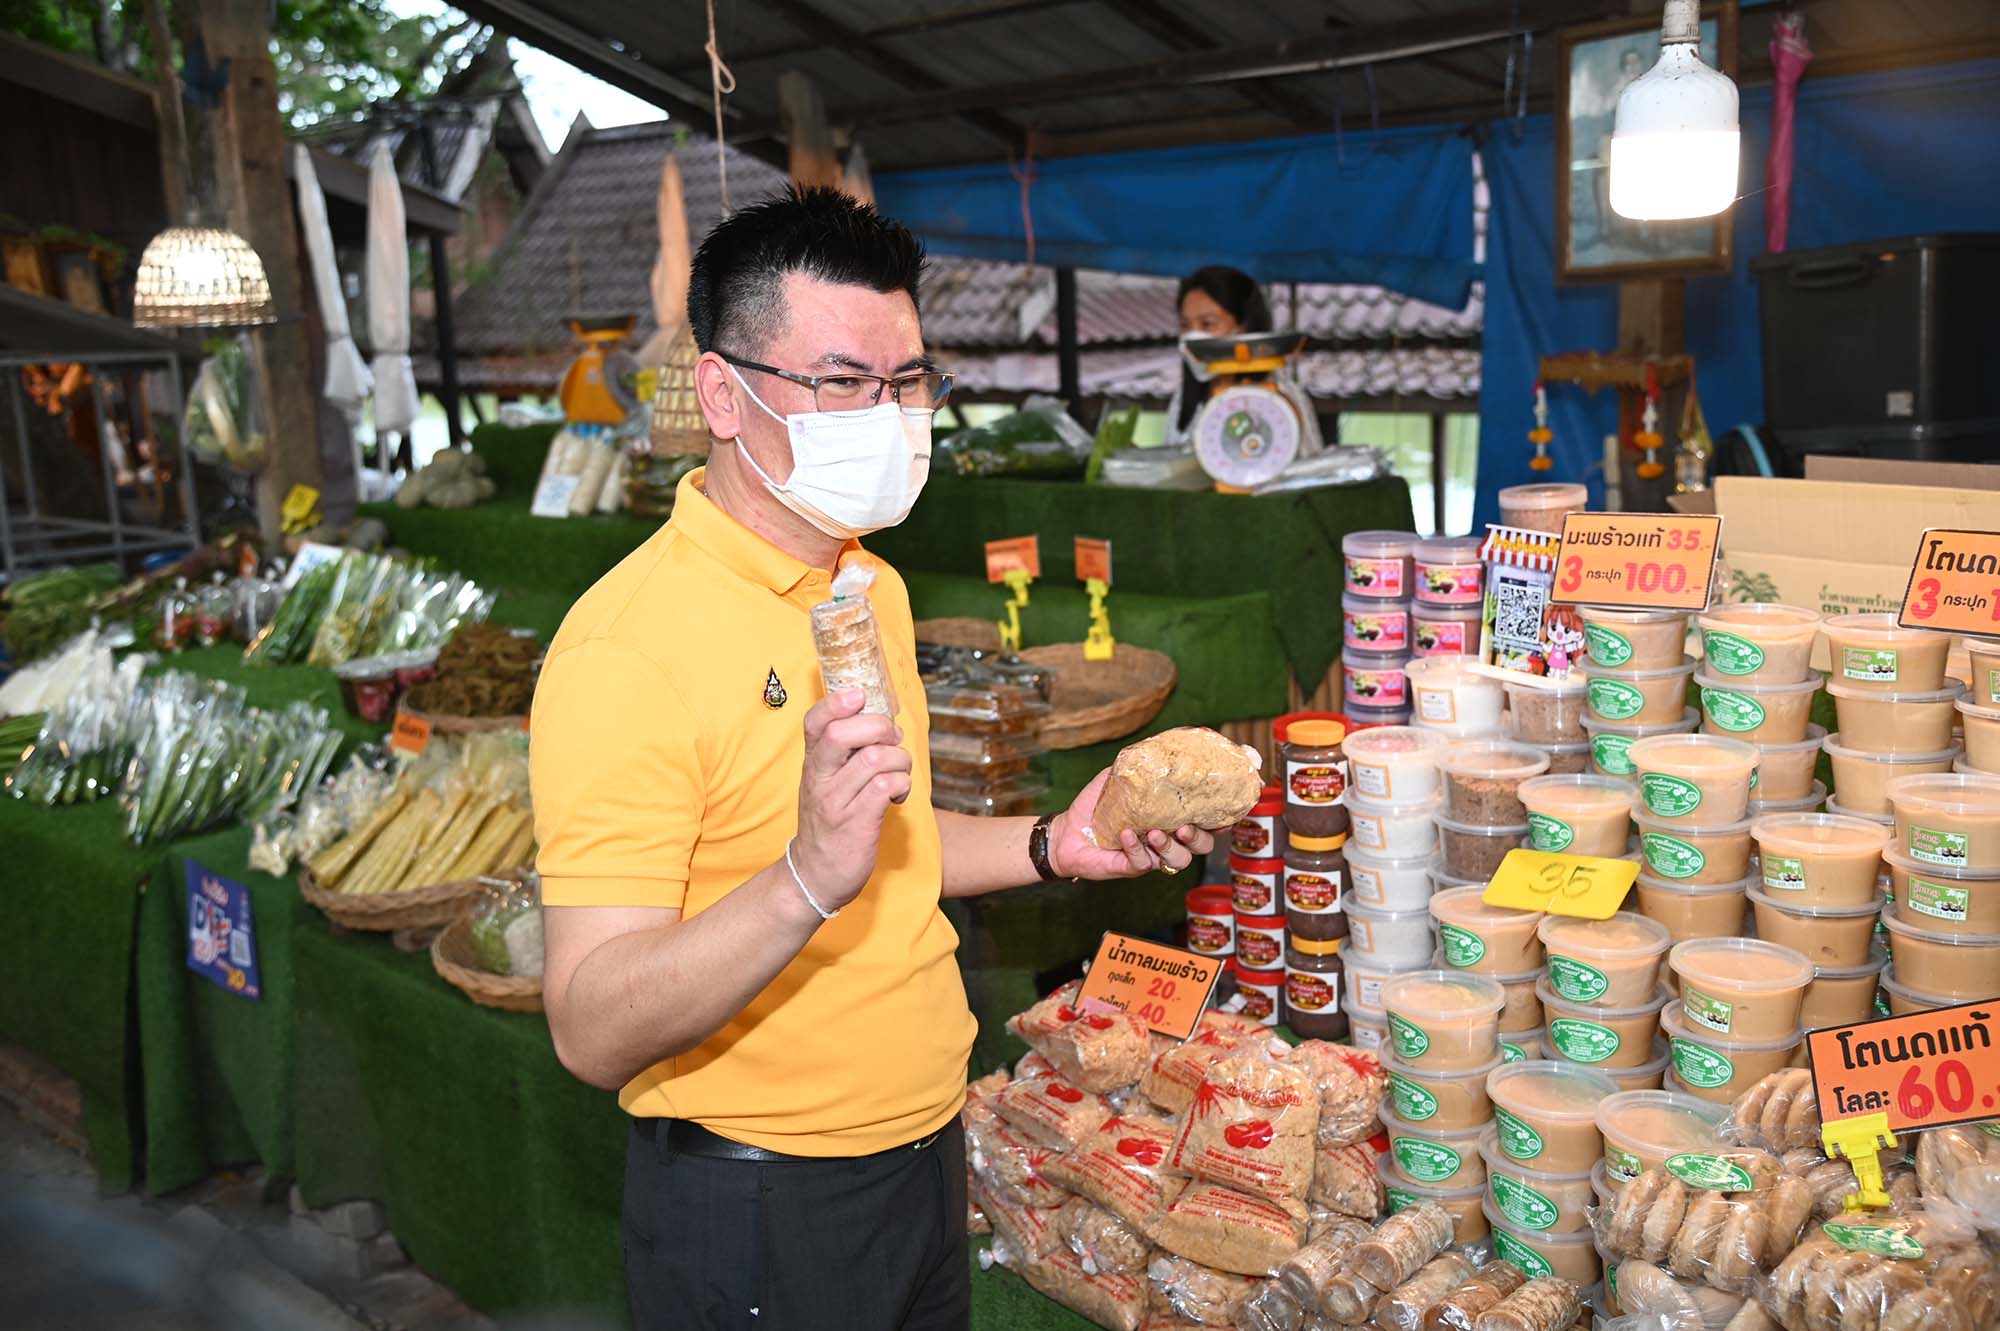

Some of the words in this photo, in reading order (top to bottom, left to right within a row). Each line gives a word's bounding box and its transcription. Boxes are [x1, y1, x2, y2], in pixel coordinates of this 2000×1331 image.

[1567, 526, 1665, 547] มะพร้าวแท้
[1560, 555, 1583, 592] 3
[1586, 569, 1621, 583] กระปุก
[1926, 540, 2000, 575] โตนด
[1911, 578, 1941, 619] 3
[1944, 594, 1987, 612] กระปุก
[1529, 862, 1600, 899] 35
[1108, 938, 1208, 983] น้ำตาลมะพร้าว
[1836, 1011, 1991, 1070] โตนดแท้
